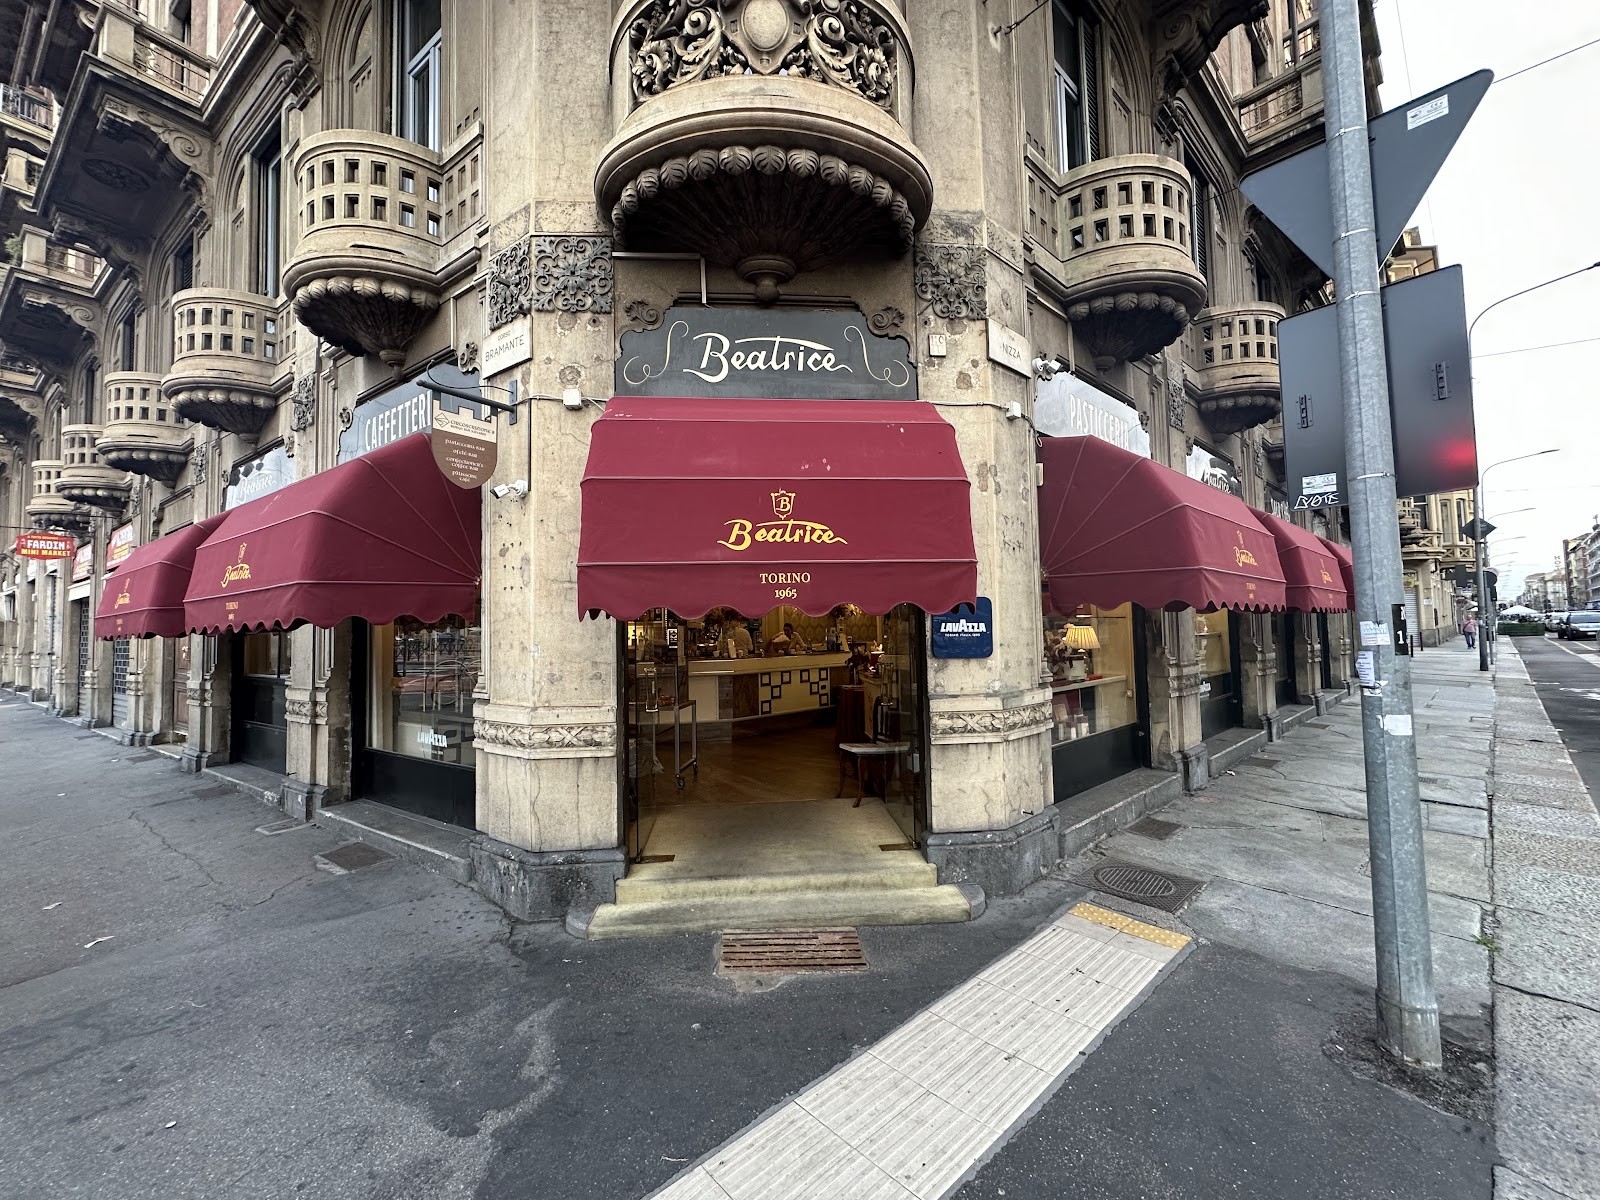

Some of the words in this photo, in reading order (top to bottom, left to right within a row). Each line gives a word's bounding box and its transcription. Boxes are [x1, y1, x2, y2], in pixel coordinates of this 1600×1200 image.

[497, 331, 511, 341] CORSO
[485, 335, 524, 362] BRAMANTE
[1002, 343, 1021, 359] NIZZA
[683, 332, 853, 383] Beatrice
[365, 391, 432, 451] CAFFETTERI
[1070, 394, 1129, 450] PASTICCERIA
[717, 519, 848, 551] Beatrice
[27, 540, 65, 550] FARDIN
[41, 549, 71, 557] MARKET
[221, 563, 251, 588] Beatrice
[760, 572, 811, 584] TORINO
[774, 587, 797, 599] 1965
[940, 619, 986, 632] LAVAZZA
